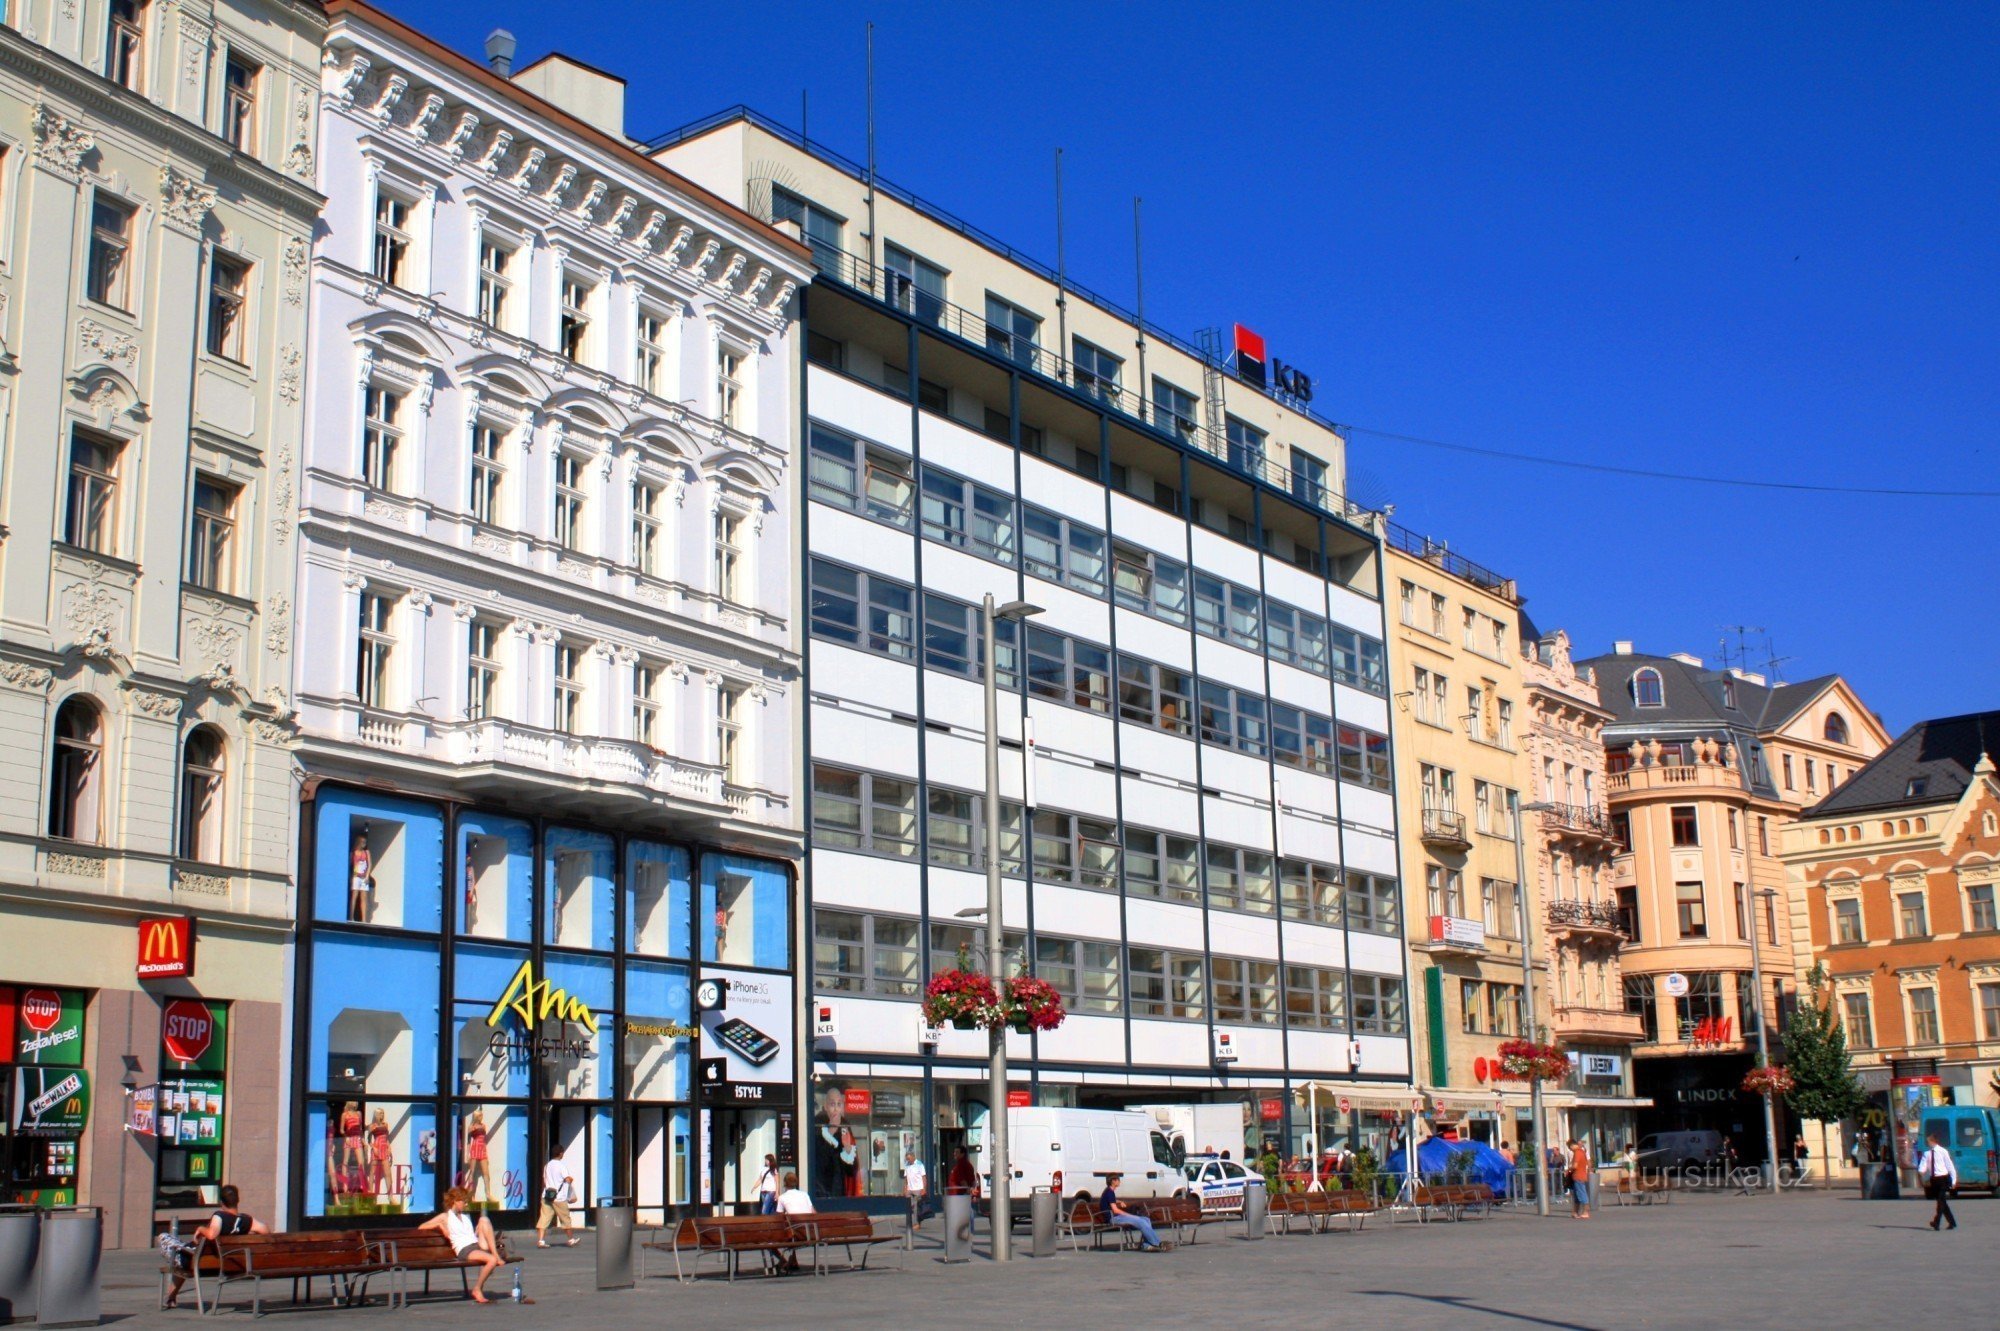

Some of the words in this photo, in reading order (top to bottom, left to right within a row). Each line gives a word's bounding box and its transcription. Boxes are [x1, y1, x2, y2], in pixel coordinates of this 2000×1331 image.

[1272, 358, 1313, 401] KB
[138, 962, 184, 973] McDonald's
[698, 987, 716, 1001] AC
[26, 998, 58, 1018] STOP
[168, 1014, 207, 1041] STOP
[817, 1025, 834, 1033] KB
[925, 1031, 937, 1040] KB
[489, 1030, 591, 1059] CHRISTINE
[734, 1085, 762, 1098] iSTYLE
[1677, 1088, 1737, 1102] LINDEX
[332, 1163, 413, 1197] SALE
